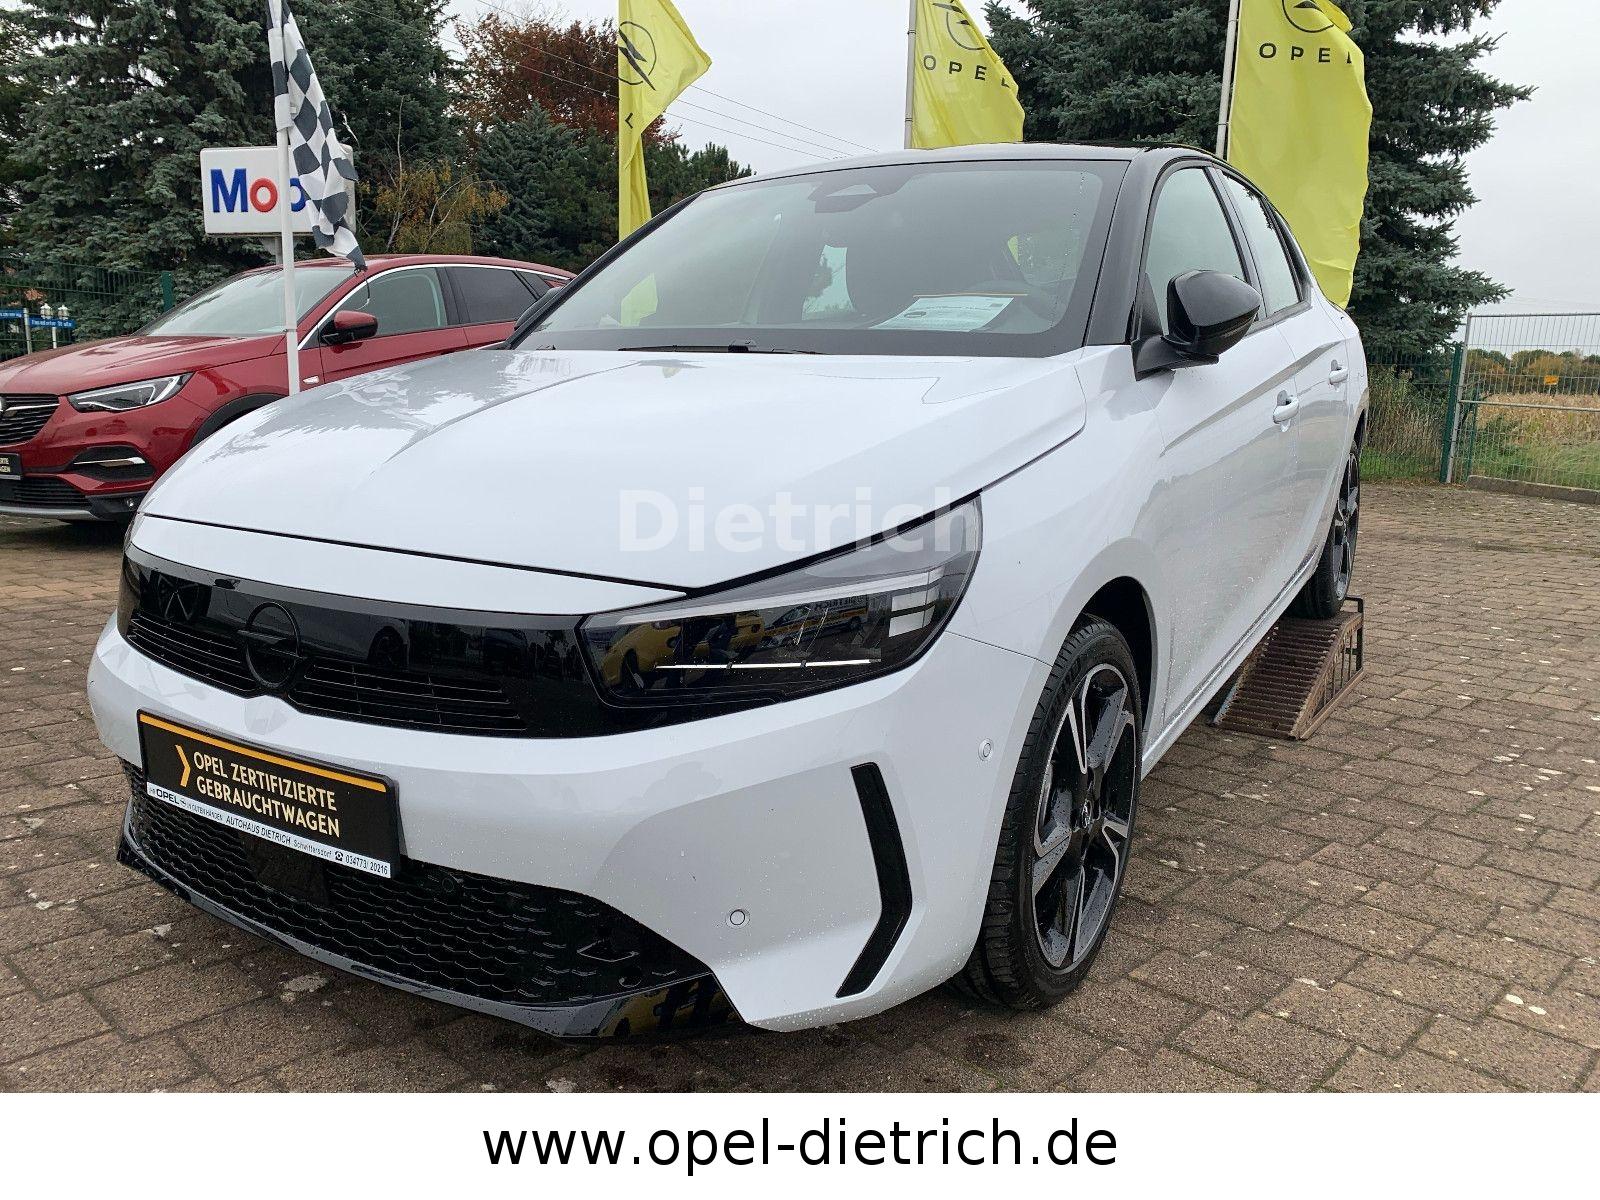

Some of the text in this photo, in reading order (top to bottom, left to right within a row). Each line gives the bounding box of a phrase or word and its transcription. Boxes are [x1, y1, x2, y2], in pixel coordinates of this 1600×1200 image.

[923, 54, 1010, 88] OPEL
[193, 751, 338, 812] OPEL ZERTIFIZIERTE
[196, 775, 340, 838] GEBRAUCHTWAGEN
[156, 788, 180, 805] OPEL
[225, 815, 260, 834] AUTOHAUS
[260, 827, 291, 845] DIETRICH
[370, 861, 388, 875] 20216
